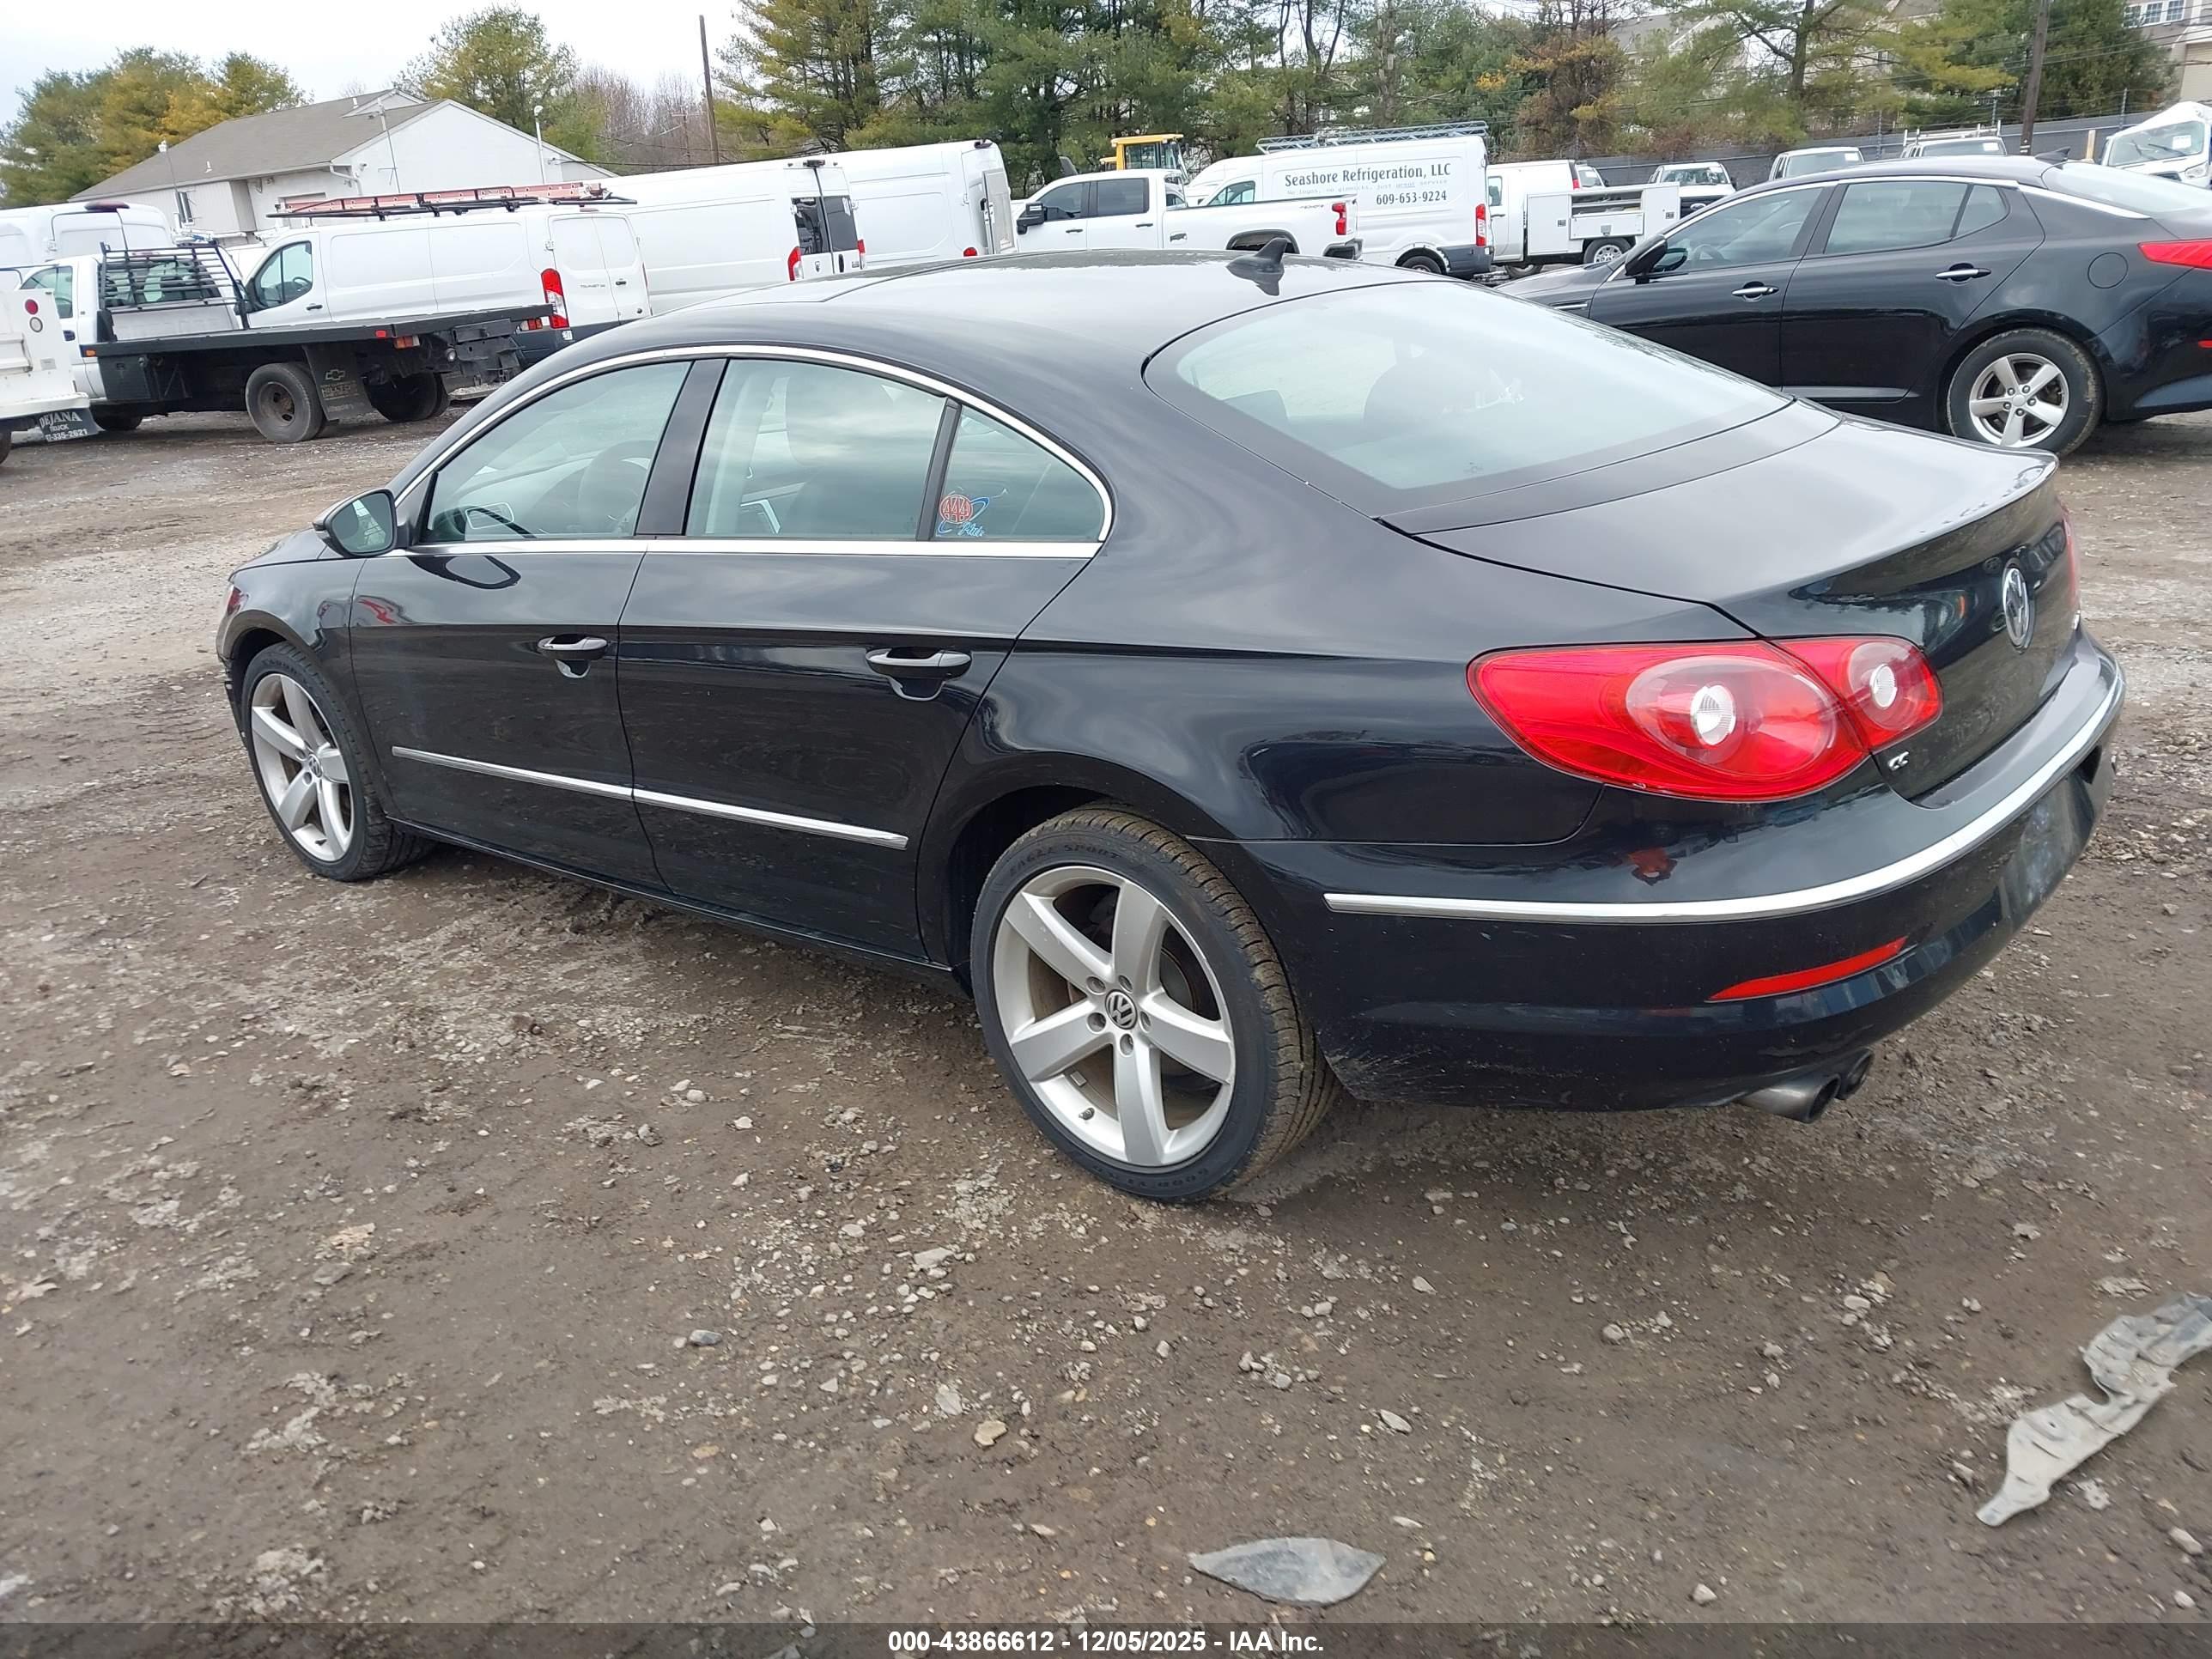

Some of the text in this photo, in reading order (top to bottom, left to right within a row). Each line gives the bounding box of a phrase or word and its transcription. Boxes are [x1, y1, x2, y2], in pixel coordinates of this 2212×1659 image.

[1285, 162, 1451, 187] Seashore Refrigeration, LLC
[1376, 190, 1448, 205] 609-653-9224
[40, 411, 83, 428] DEJANA
